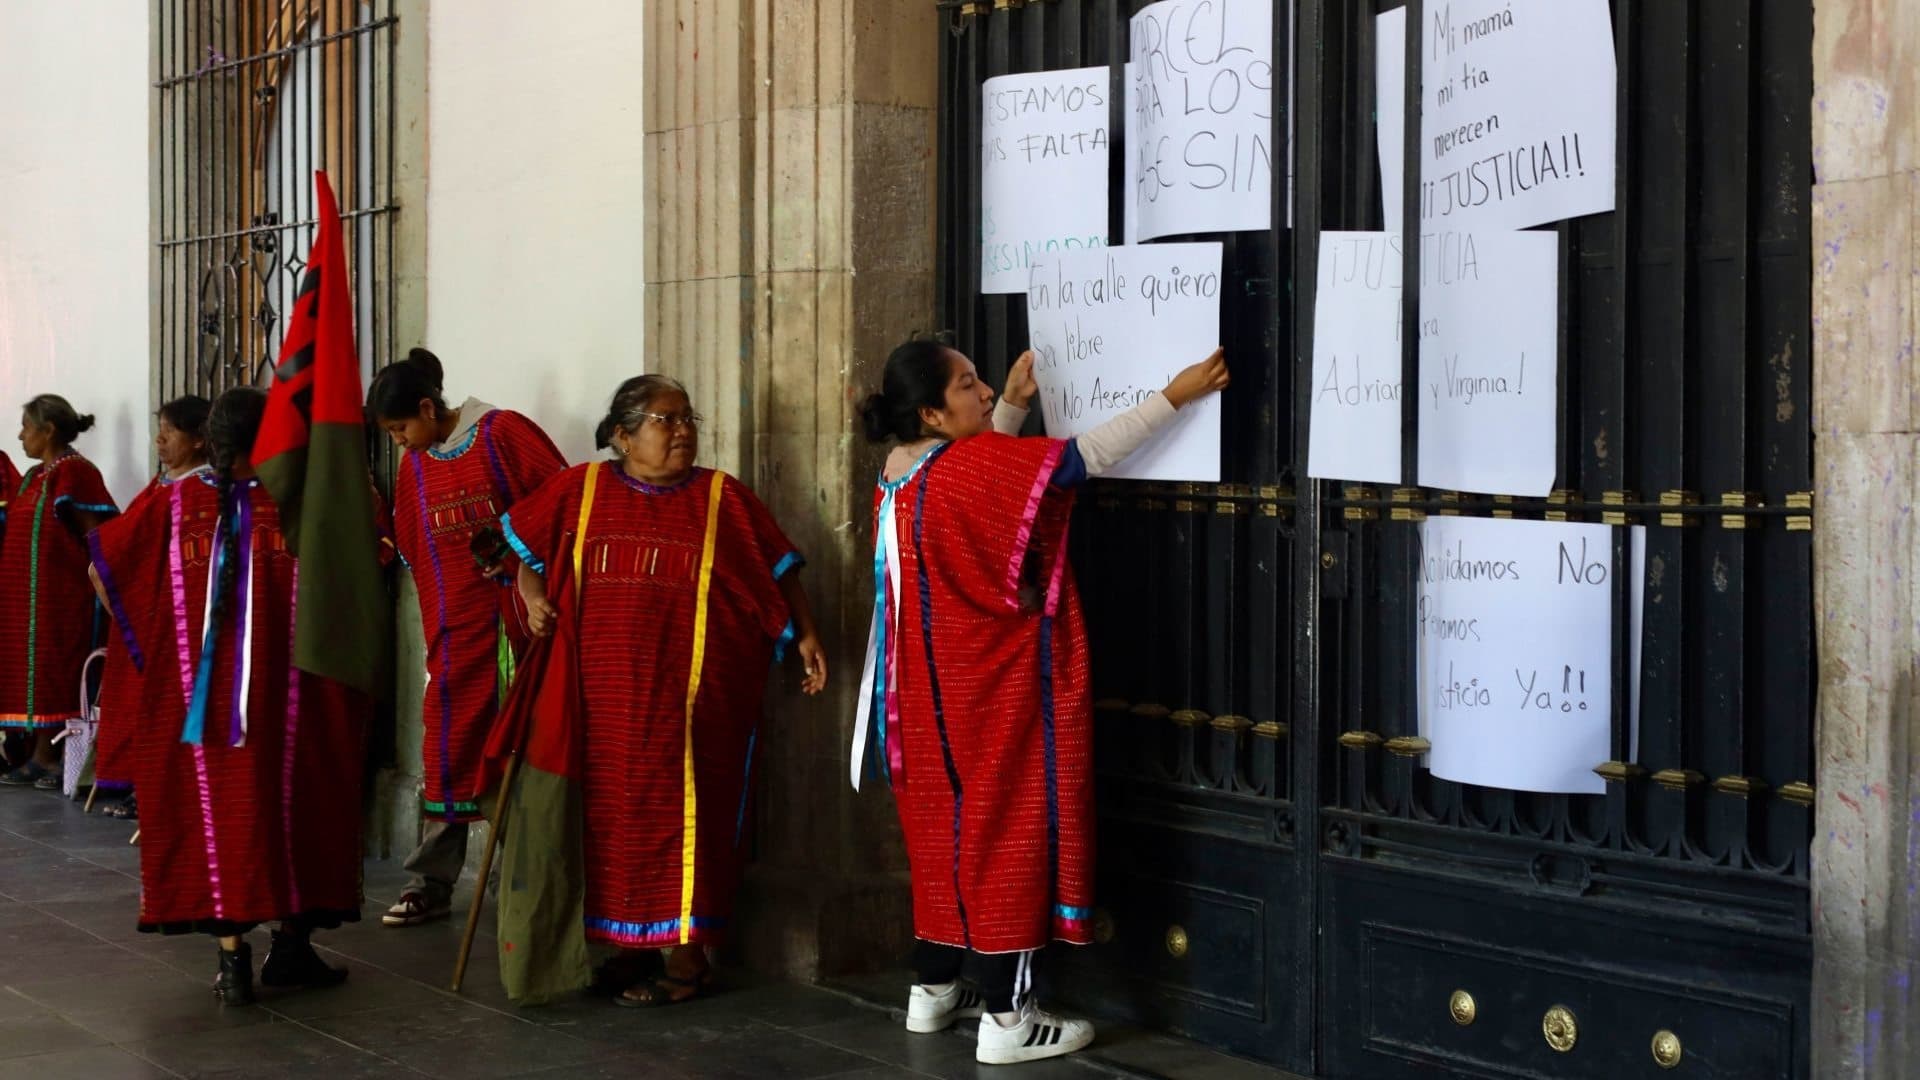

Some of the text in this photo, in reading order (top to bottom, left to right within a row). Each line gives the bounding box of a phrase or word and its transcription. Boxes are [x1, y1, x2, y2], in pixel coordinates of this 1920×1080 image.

[1433, 2, 1456, 62] Mi
[1437, 78, 1454, 107] mi
[1433, 113, 1500, 160] merecen
[1057, 258, 1075, 309] la
[1083, 252, 1127, 307] calle
[1140, 265, 1218, 317] quiero
[1064, 314, 1104, 364] libre
[1558, 536, 1607, 585] No
